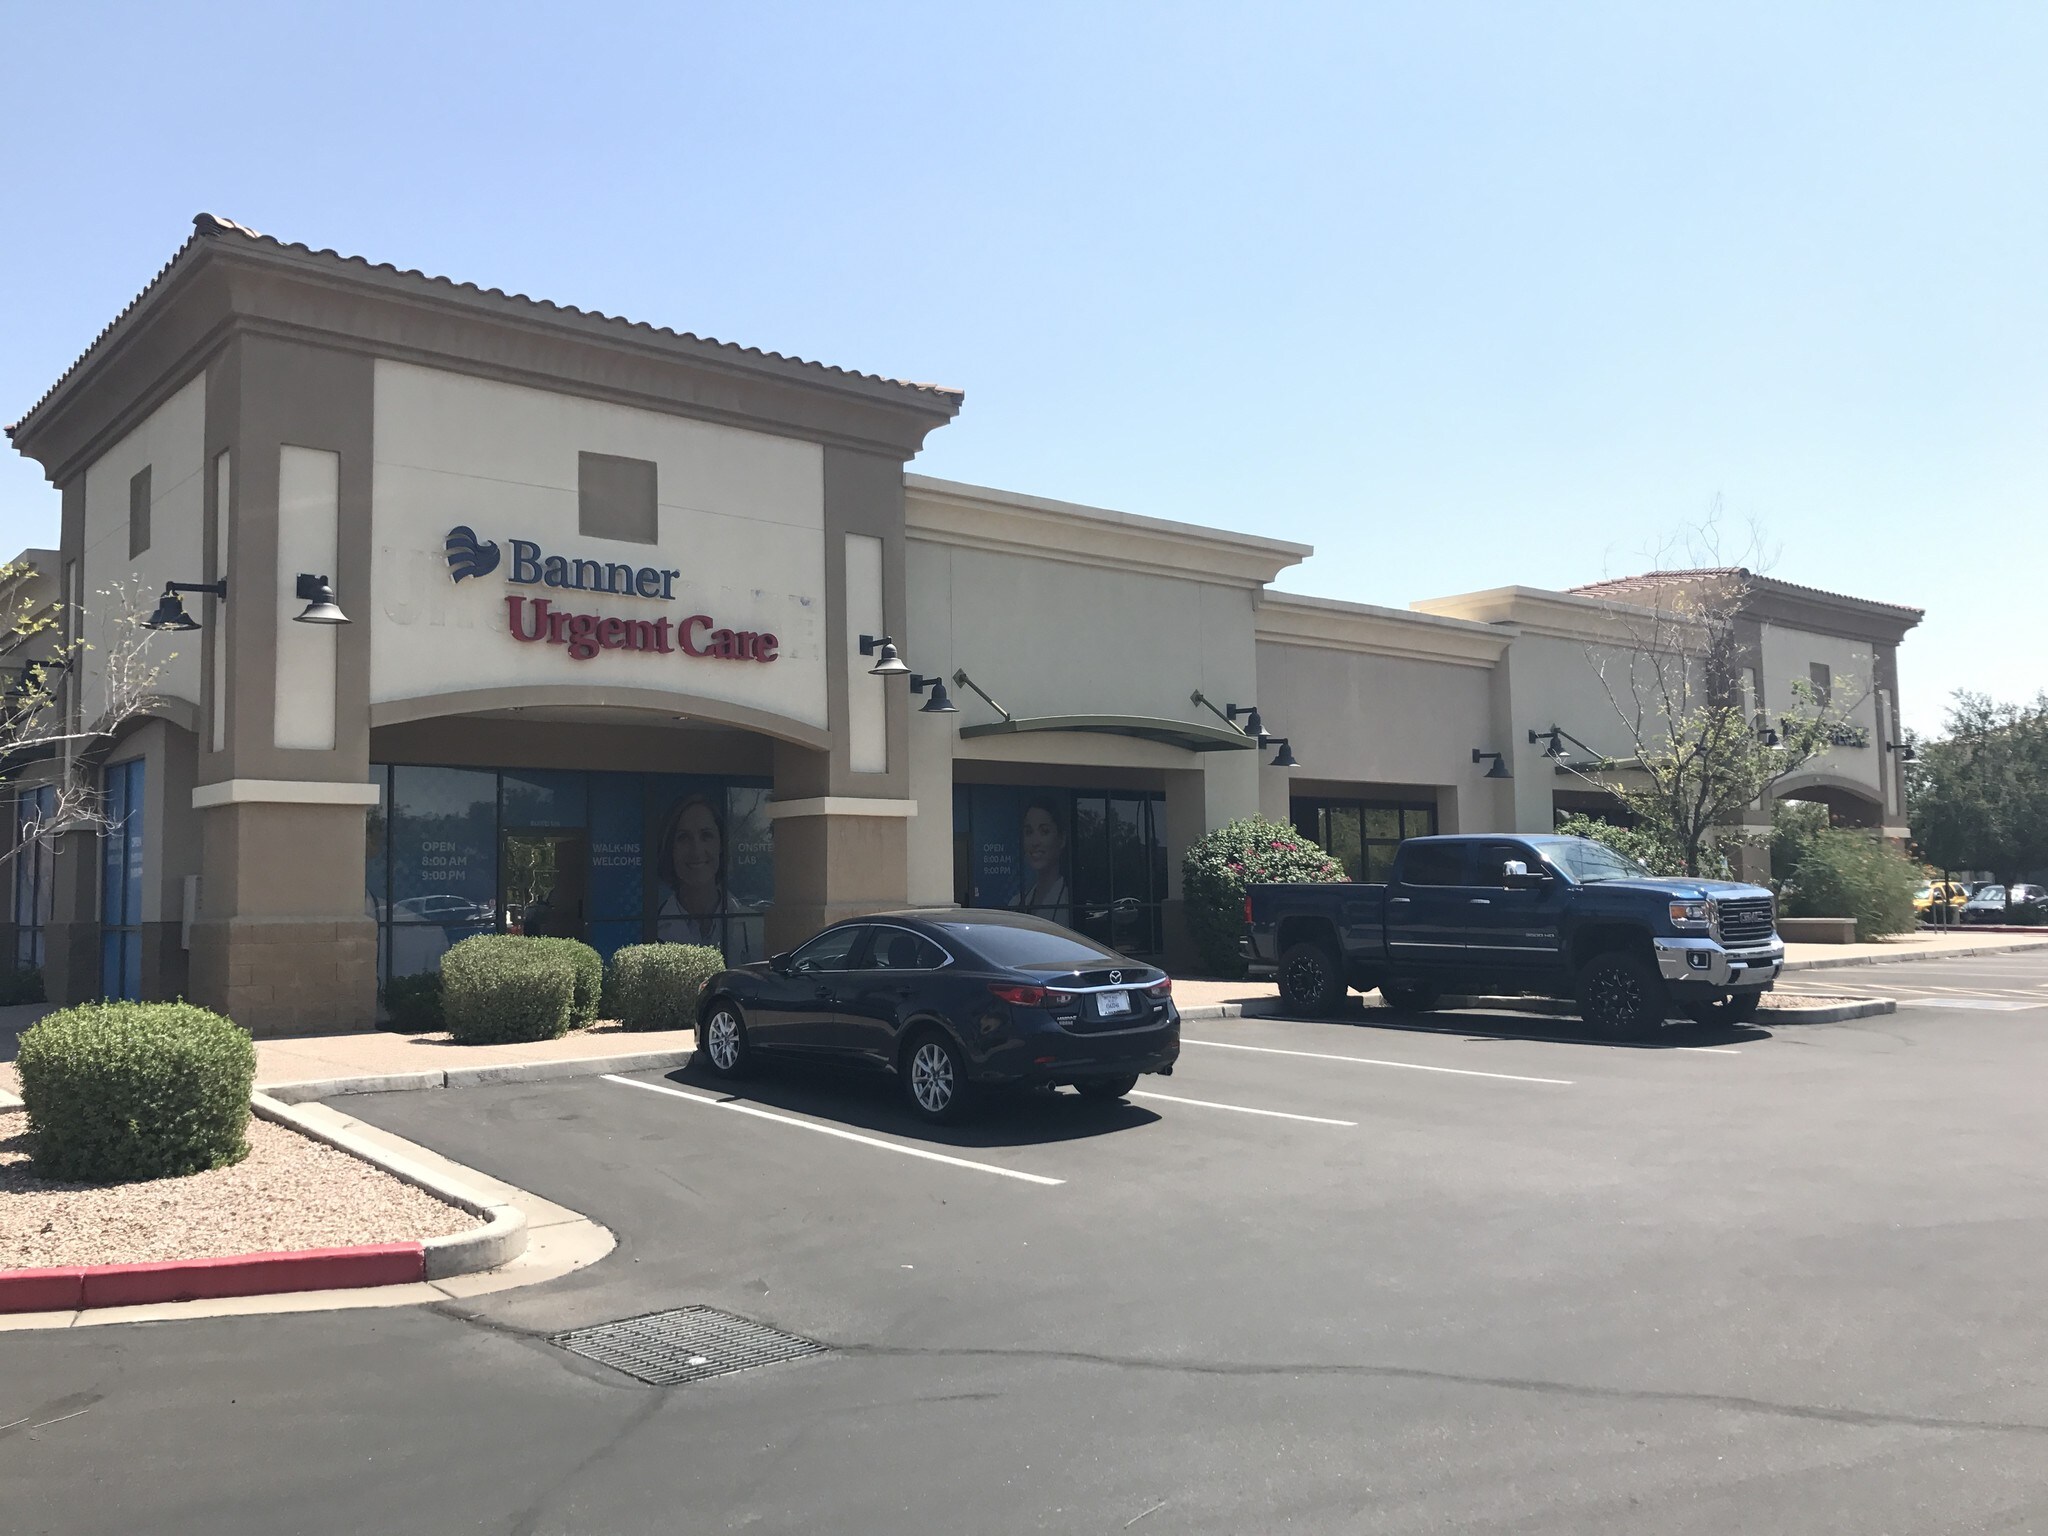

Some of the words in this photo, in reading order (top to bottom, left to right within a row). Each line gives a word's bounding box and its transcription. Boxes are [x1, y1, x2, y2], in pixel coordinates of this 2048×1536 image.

[506, 538, 680, 600] Banner
[505, 595, 674, 660] Urgent
[678, 614, 779, 663] Care
[422, 841, 456, 852] OPEN
[592, 843, 641, 853] WALK-INS
[738, 843, 774, 852] ONSITE
[983, 843, 1004, 852] OPEN
[421, 856, 447, 866] 8:00
[448, 856, 467, 866] AM
[592, 856, 642, 866] WELCOME
[738, 855, 757, 865] LAB
[999, 855, 1012, 864] AM
[422, 870, 447, 881] 9:00
[448, 870, 466, 881] PM
[1000, 866, 1011, 875] PM
[1739, 911, 1763, 924] GMC
